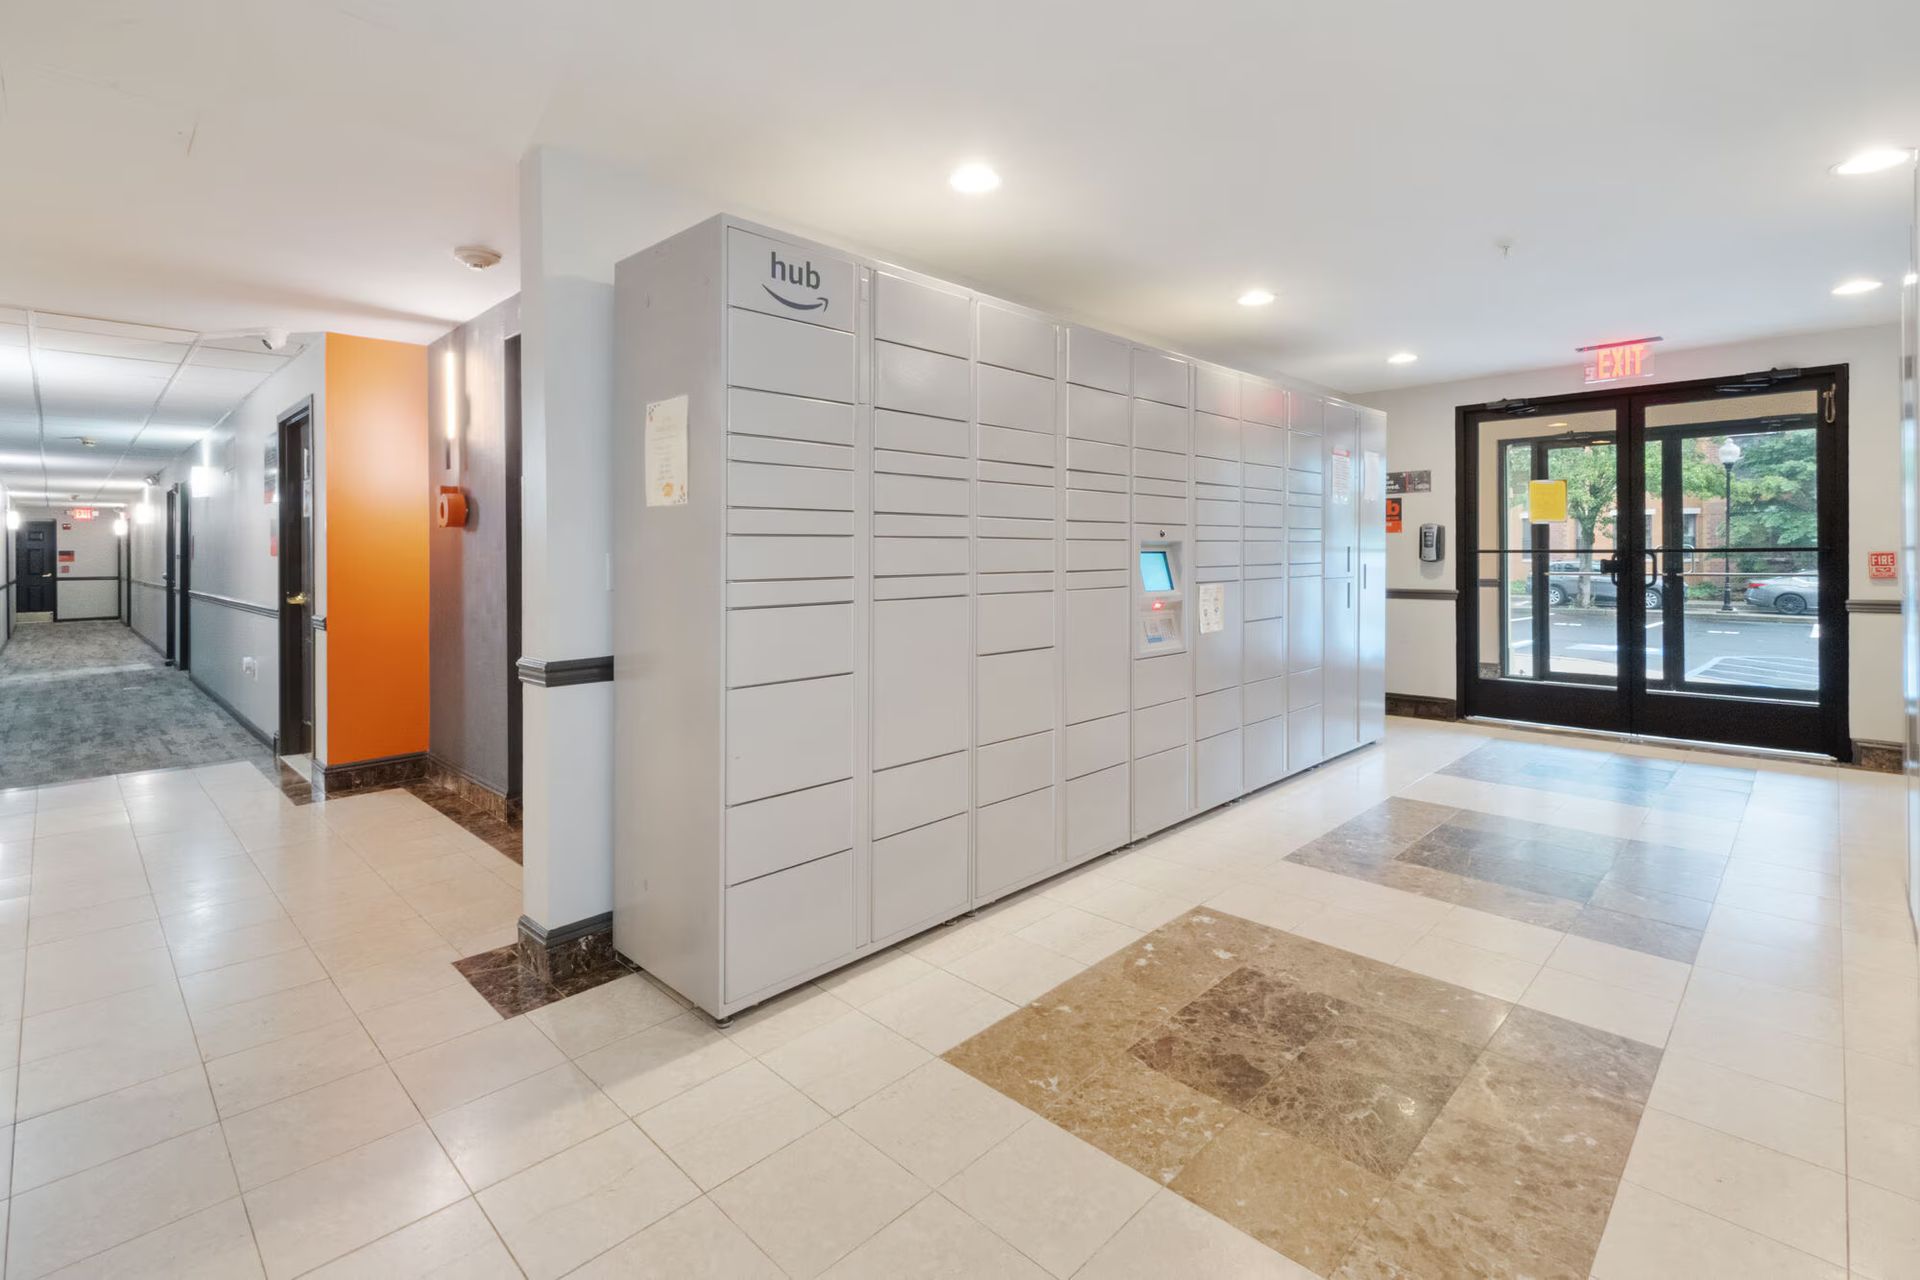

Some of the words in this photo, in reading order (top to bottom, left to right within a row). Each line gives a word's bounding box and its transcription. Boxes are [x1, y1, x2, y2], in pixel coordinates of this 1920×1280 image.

[771, 251, 821, 290] hub
[1597, 343, 1645, 379] EXIT
[1386, 499, 1400, 516] b
[1871, 553, 1896, 566] FIRE
